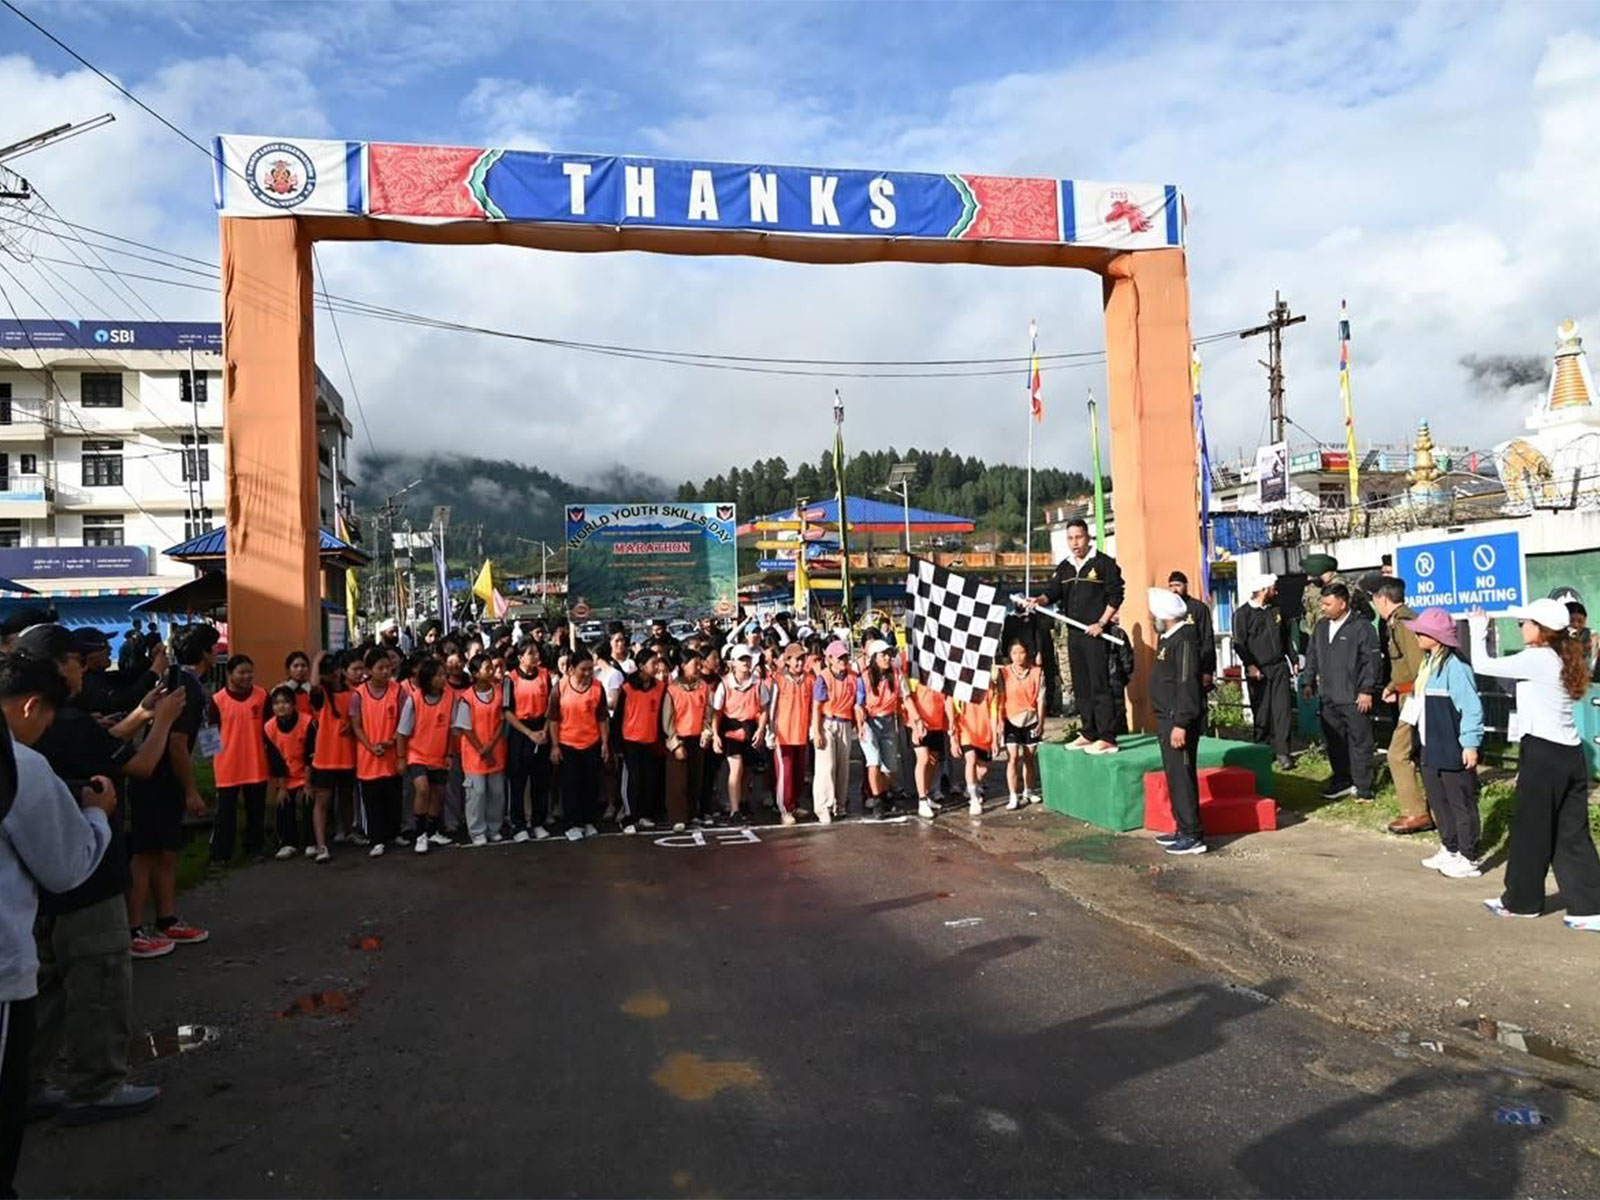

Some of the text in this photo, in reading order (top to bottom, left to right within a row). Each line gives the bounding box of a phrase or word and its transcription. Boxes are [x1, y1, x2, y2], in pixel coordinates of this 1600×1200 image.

[563, 162, 897, 229] THANKS
[110, 330, 134, 343] SBI
[568, 506, 732, 549] WORLD YOUTH SKILLS DAY
[613, 542, 690, 554] MARATHON
[1417, 582, 1434, 593] NO
[1476, 576, 1495, 588] NO
[1458, 587, 1517, 604] WAITING
